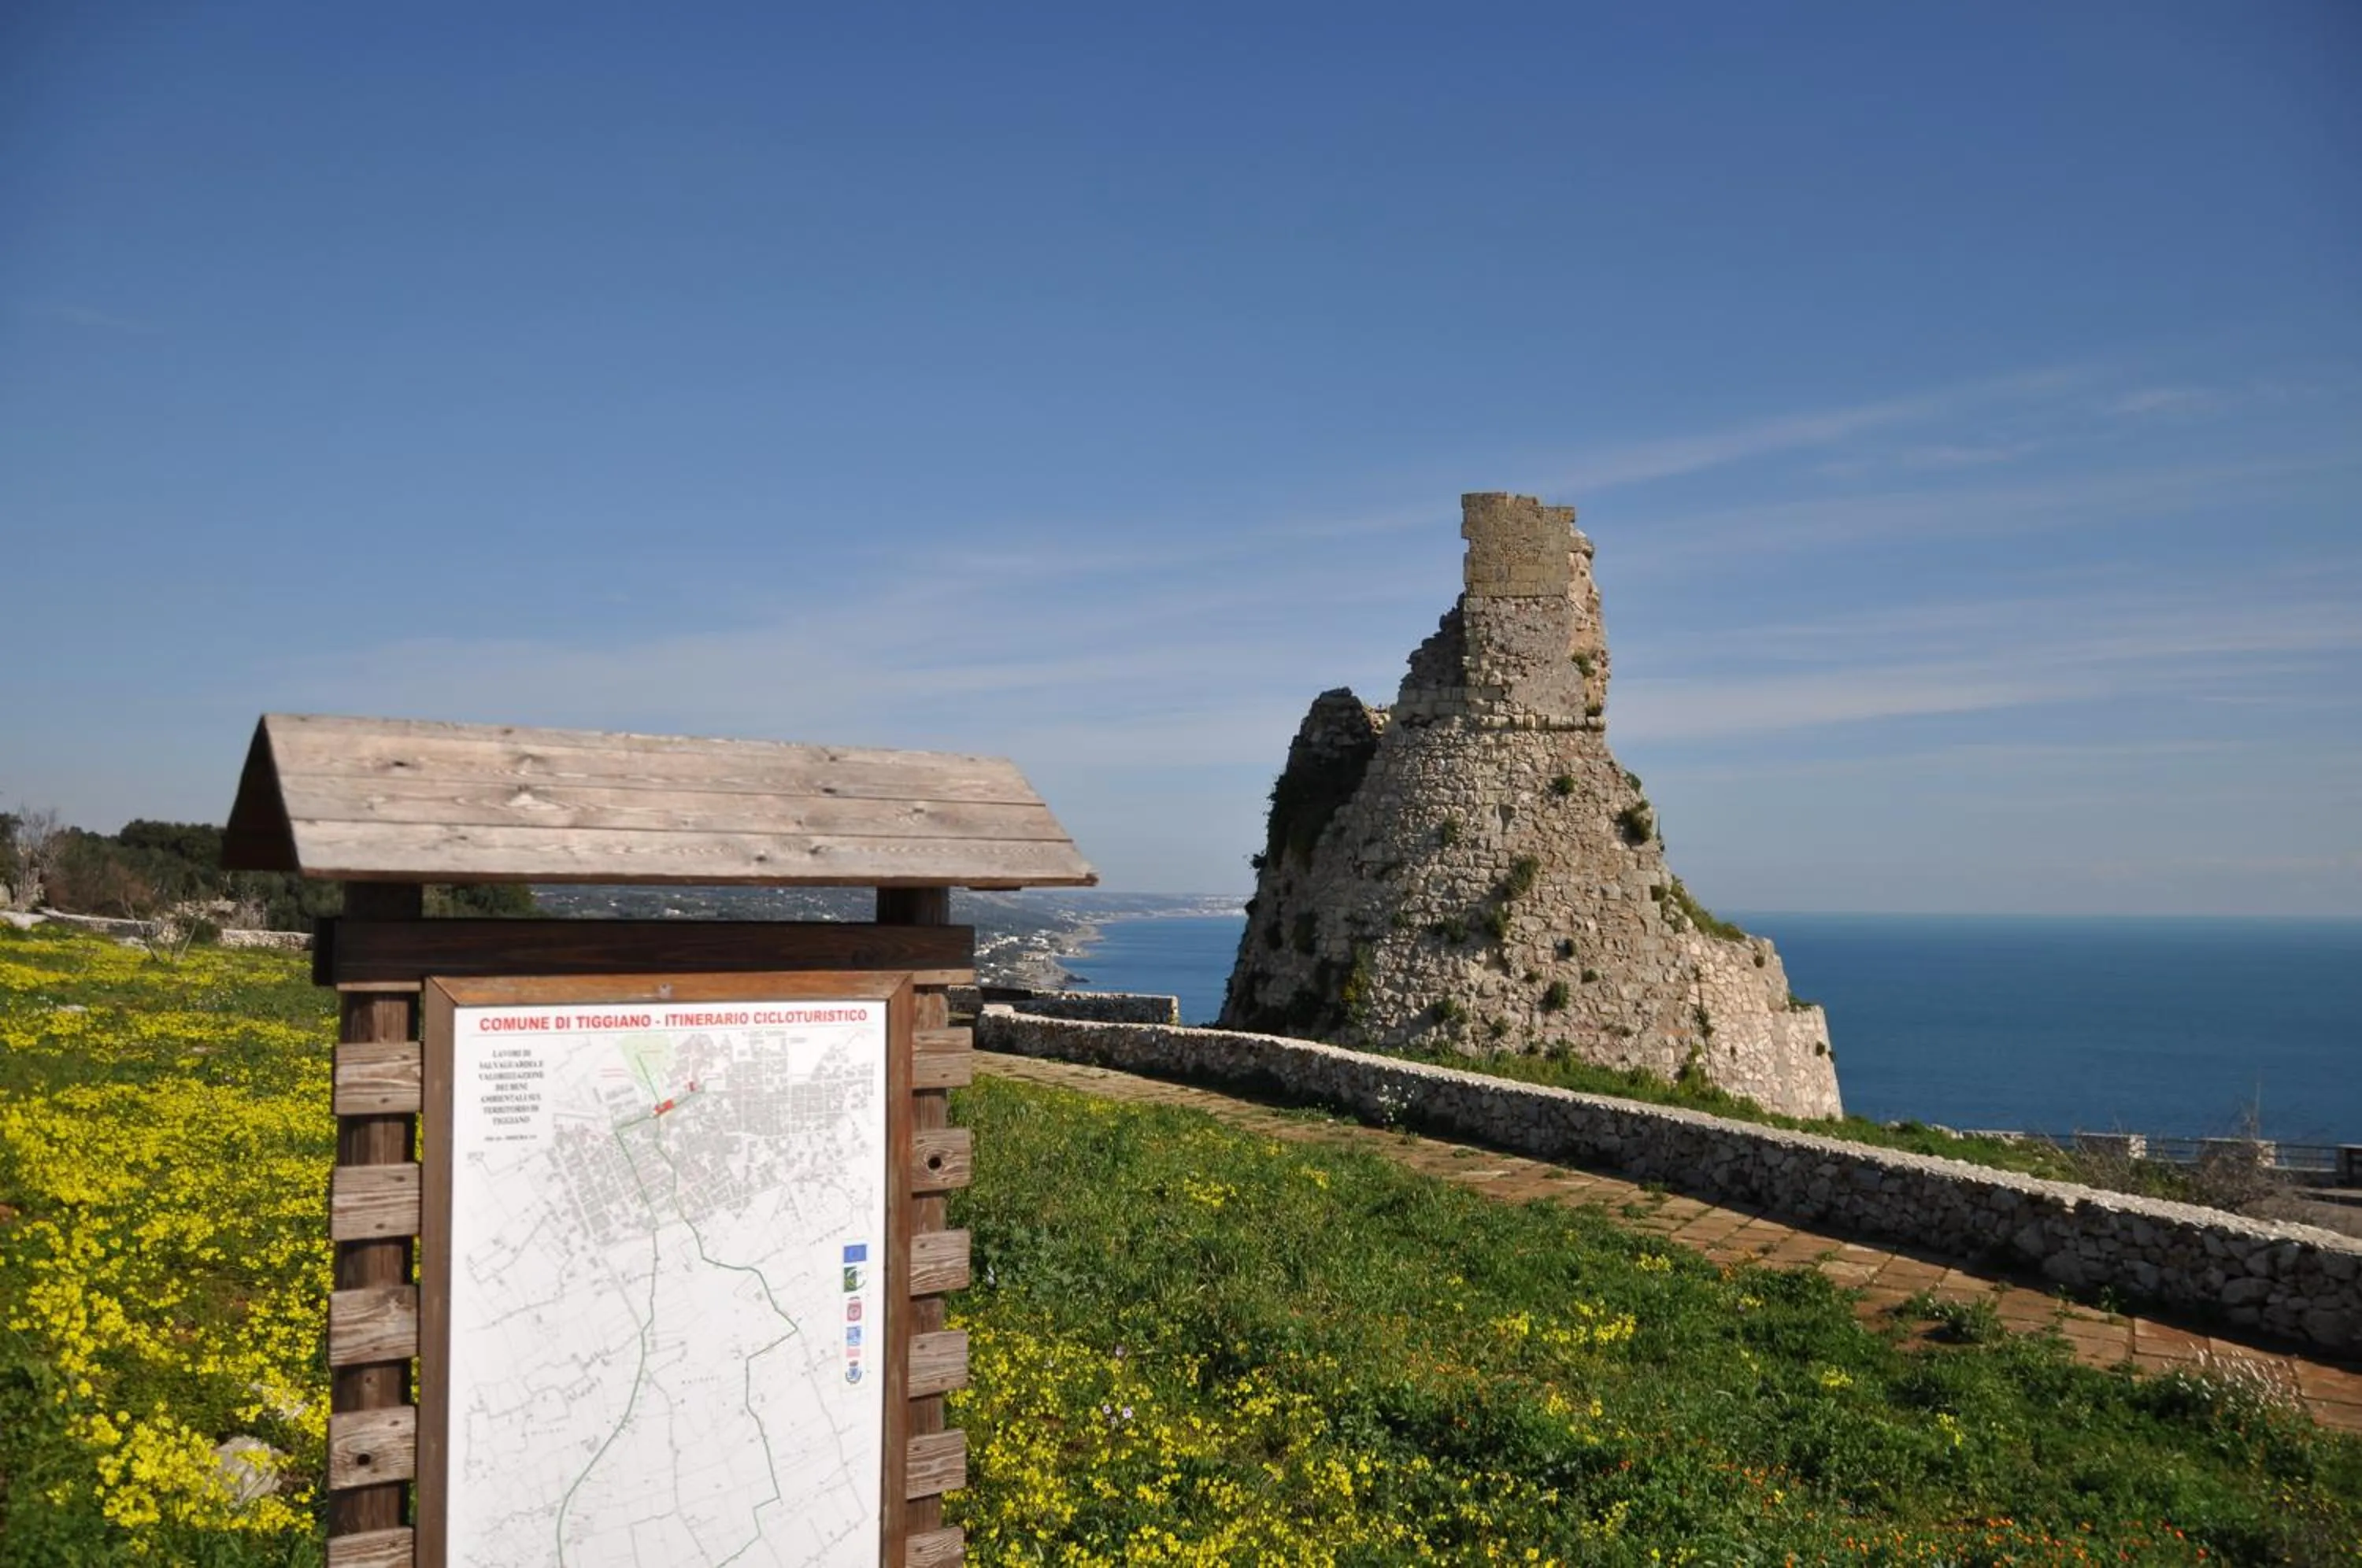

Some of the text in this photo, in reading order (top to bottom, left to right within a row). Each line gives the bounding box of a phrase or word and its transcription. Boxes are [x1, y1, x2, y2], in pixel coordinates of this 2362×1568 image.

[479, 1016, 550, 1030] COMUNE
[555, 1016, 570, 1030] DI
[576, 1014, 652, 1029] TIGGIANO
[665, 1012, 749, 1027] ITINERARIO
[753, 1009, 868, 1024] CICLOTURISTICO
[479, 1071, 544, 1081] VALORIZZAZIONE
[492, 1115, 531, 1126] TIGGIANO
